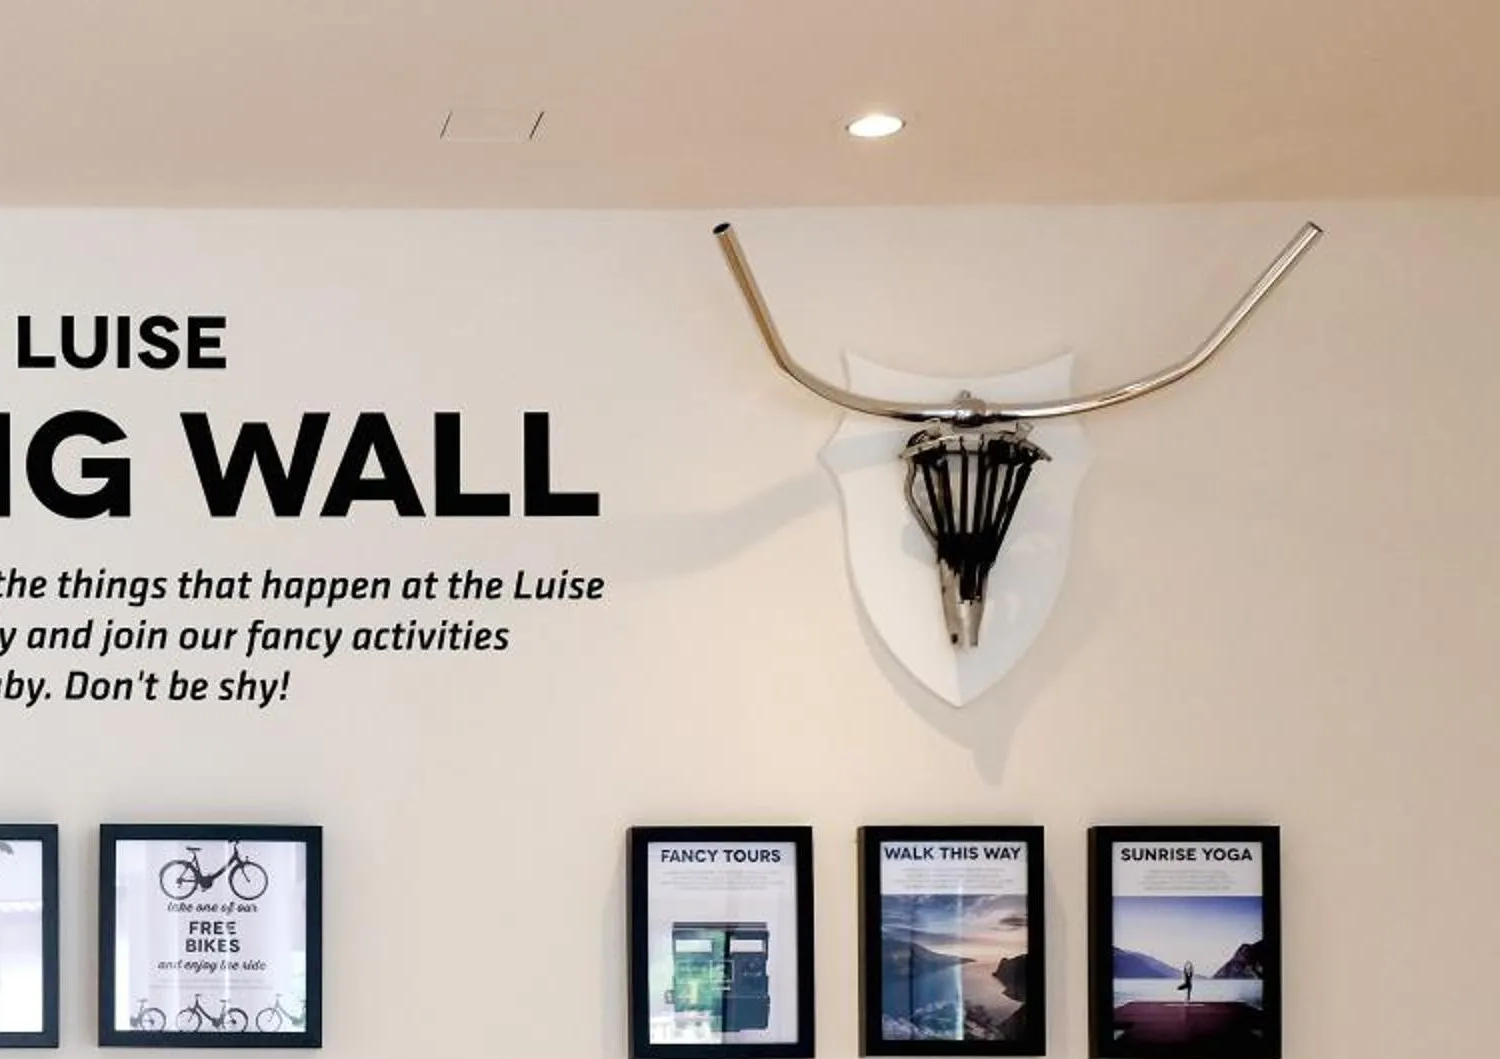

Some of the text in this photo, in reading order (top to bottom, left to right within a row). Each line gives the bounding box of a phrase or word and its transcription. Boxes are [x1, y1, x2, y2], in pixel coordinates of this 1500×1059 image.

[17, 314, 227, 371] LUISE
[179, 411, 601, 518] WALL
[57, 567, 168, 607] things
[177, 568, 253, 600] that
[261, 568, 391, 607] happen
[401, 571, 439, 601] at
[447, 569, 504, 601] the
[513, 568, 605, 601] Luise
[26, 618, 94, 650] and
[99, 618, 168, 657] join
[178, 627, 239, 651] our
[245, 619, 343, 657] fancy
[351, 619, 510, 651] activities
[64, 669, 160, 701] Don't
[168, 669, 209, 701] be
[217, 669, 291, 709] shy!
[660, 848, 782, 864] FANCY TOURS
[883, 846, 1022, 861] WALK THIS WAY
[1120, 847, 1253, 862] SUNRISE YOGA
[188, 920, 237, 936] FREE
[185, 937, 241, 953] BIKES
[183, 959, 218, 975] enjoy
